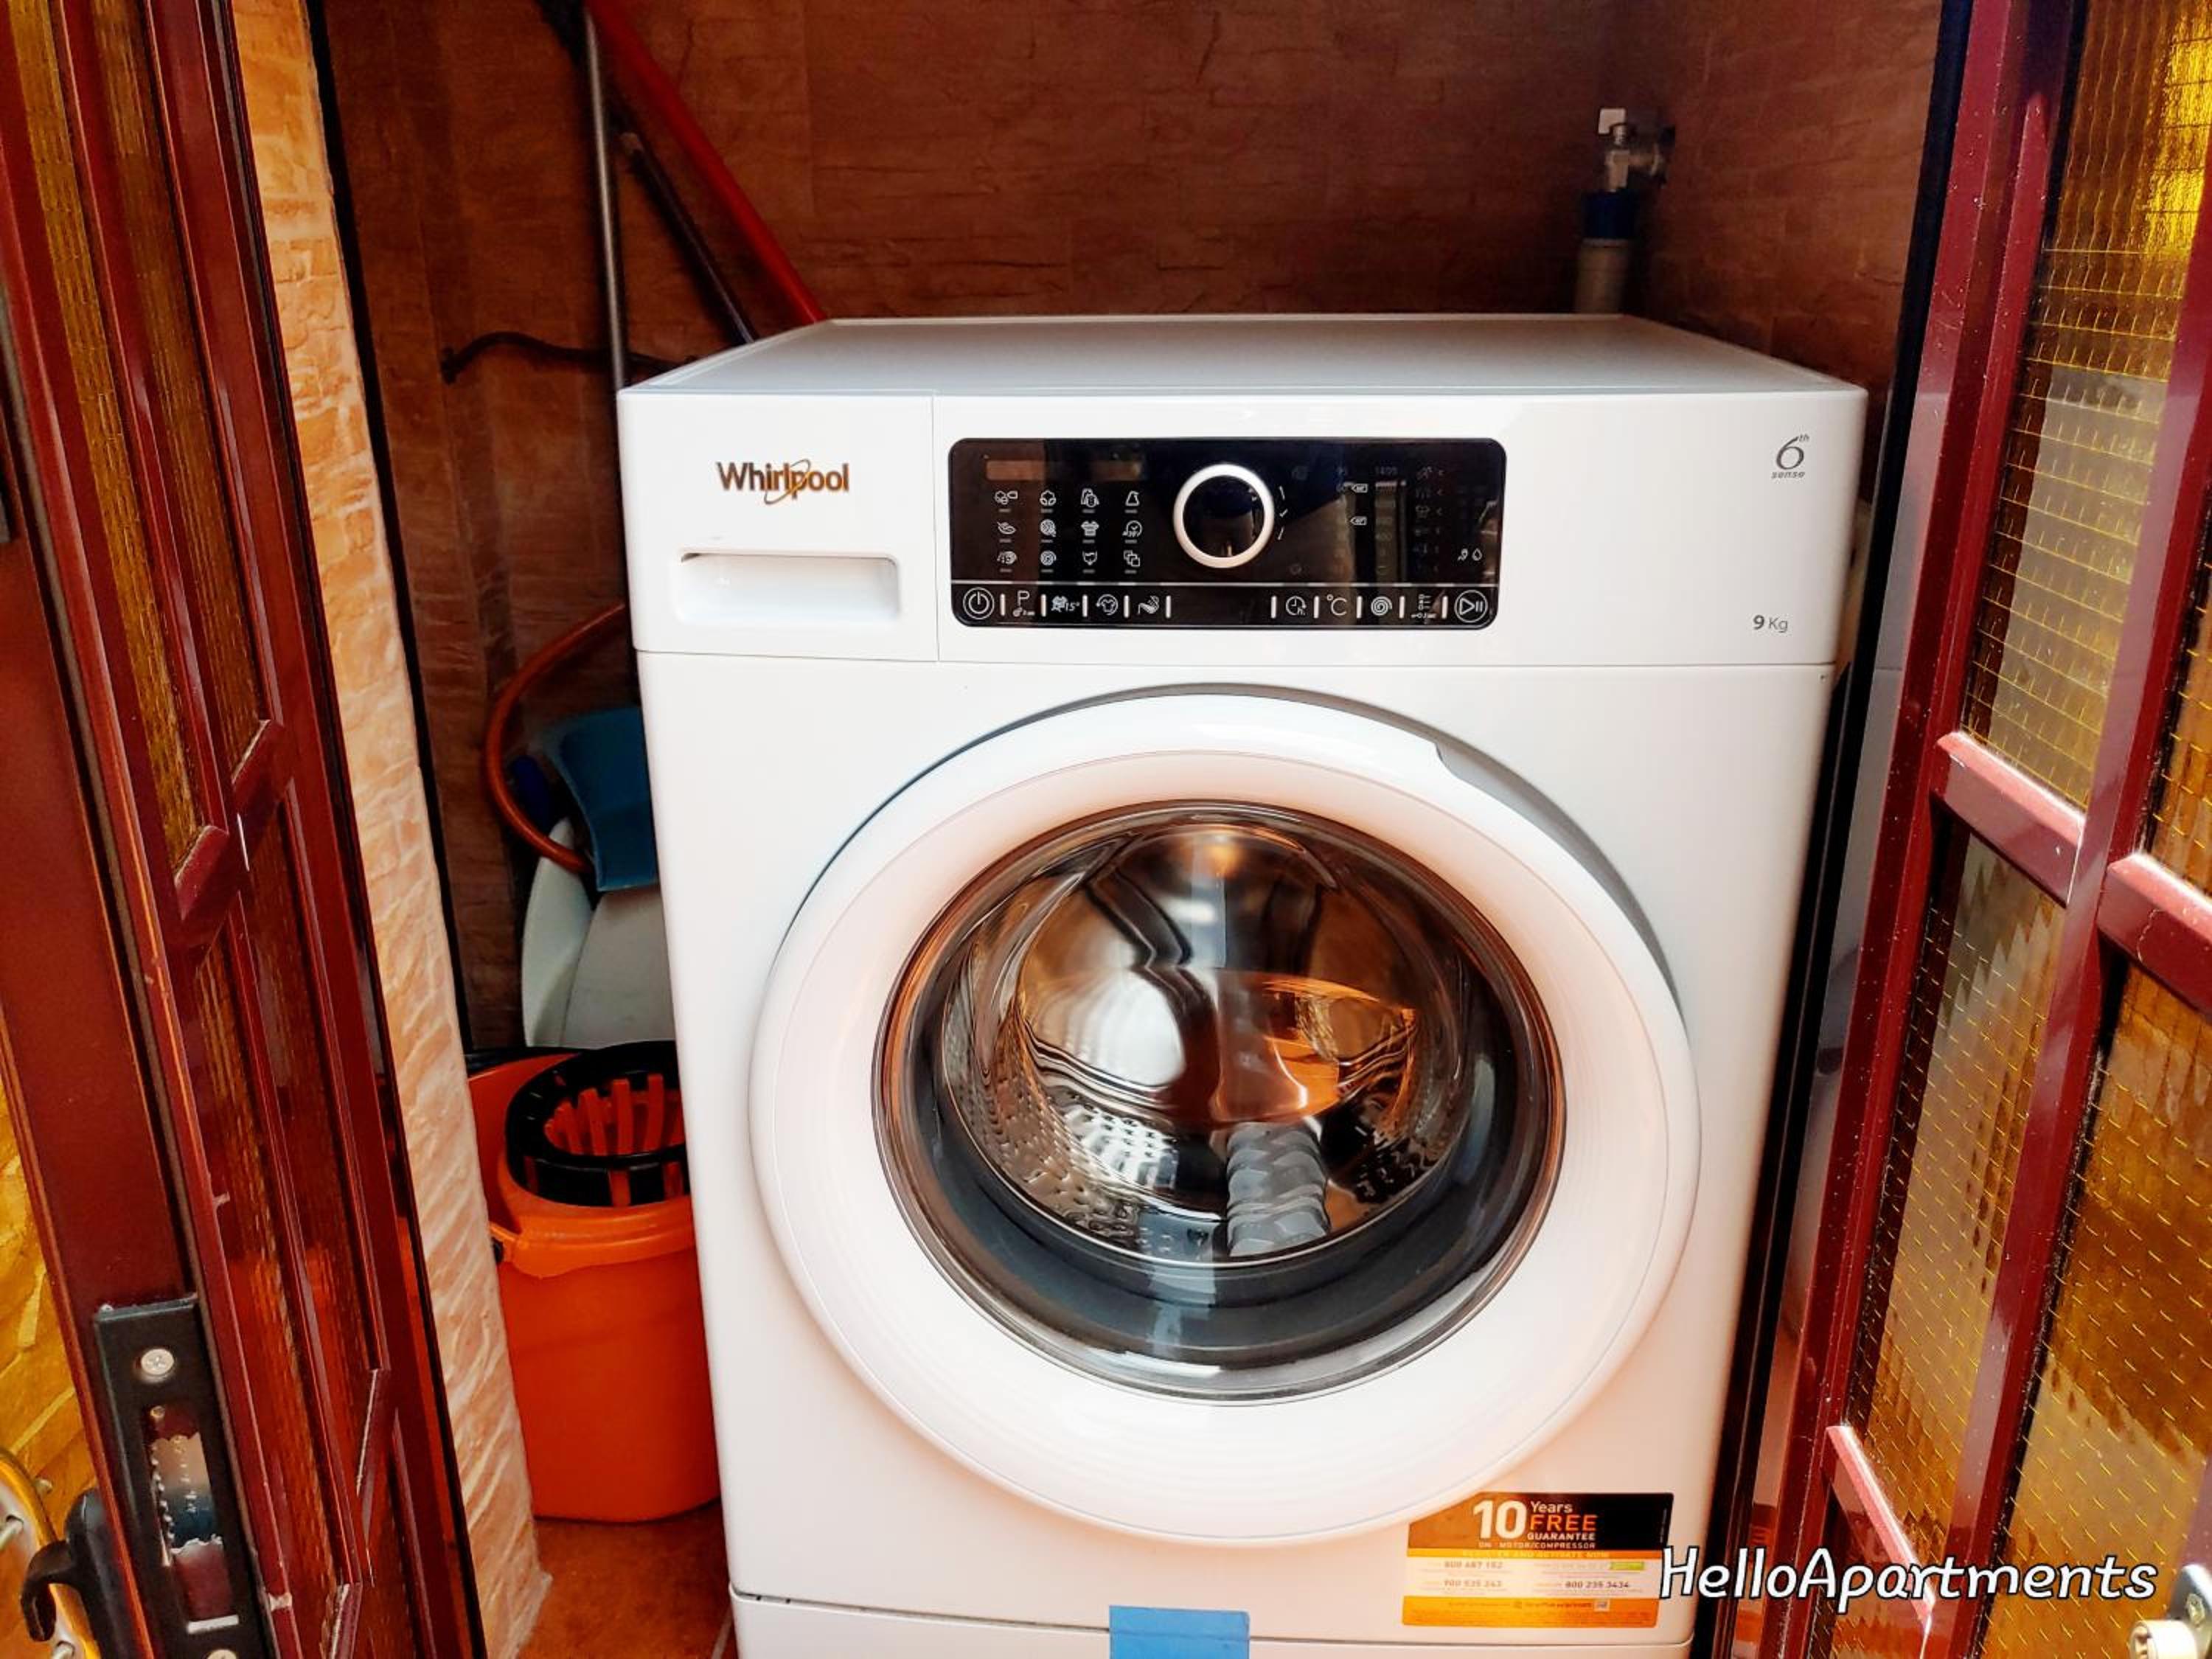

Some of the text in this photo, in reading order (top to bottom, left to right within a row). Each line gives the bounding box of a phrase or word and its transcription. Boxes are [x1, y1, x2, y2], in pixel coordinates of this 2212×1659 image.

[714, 461, 850, 500] Whirlpool
[1771, 470, 1806, 479] sense
[1752, 614, 1789, 633] 9 Kg
[1530, 1500, 1573, 1513] Years
[1472, 1499, 1528, 1540] 10
[1529, 1514, 1599, 1531] FREE
[1526, 1531, 1596, 1541] GUARANTEE
